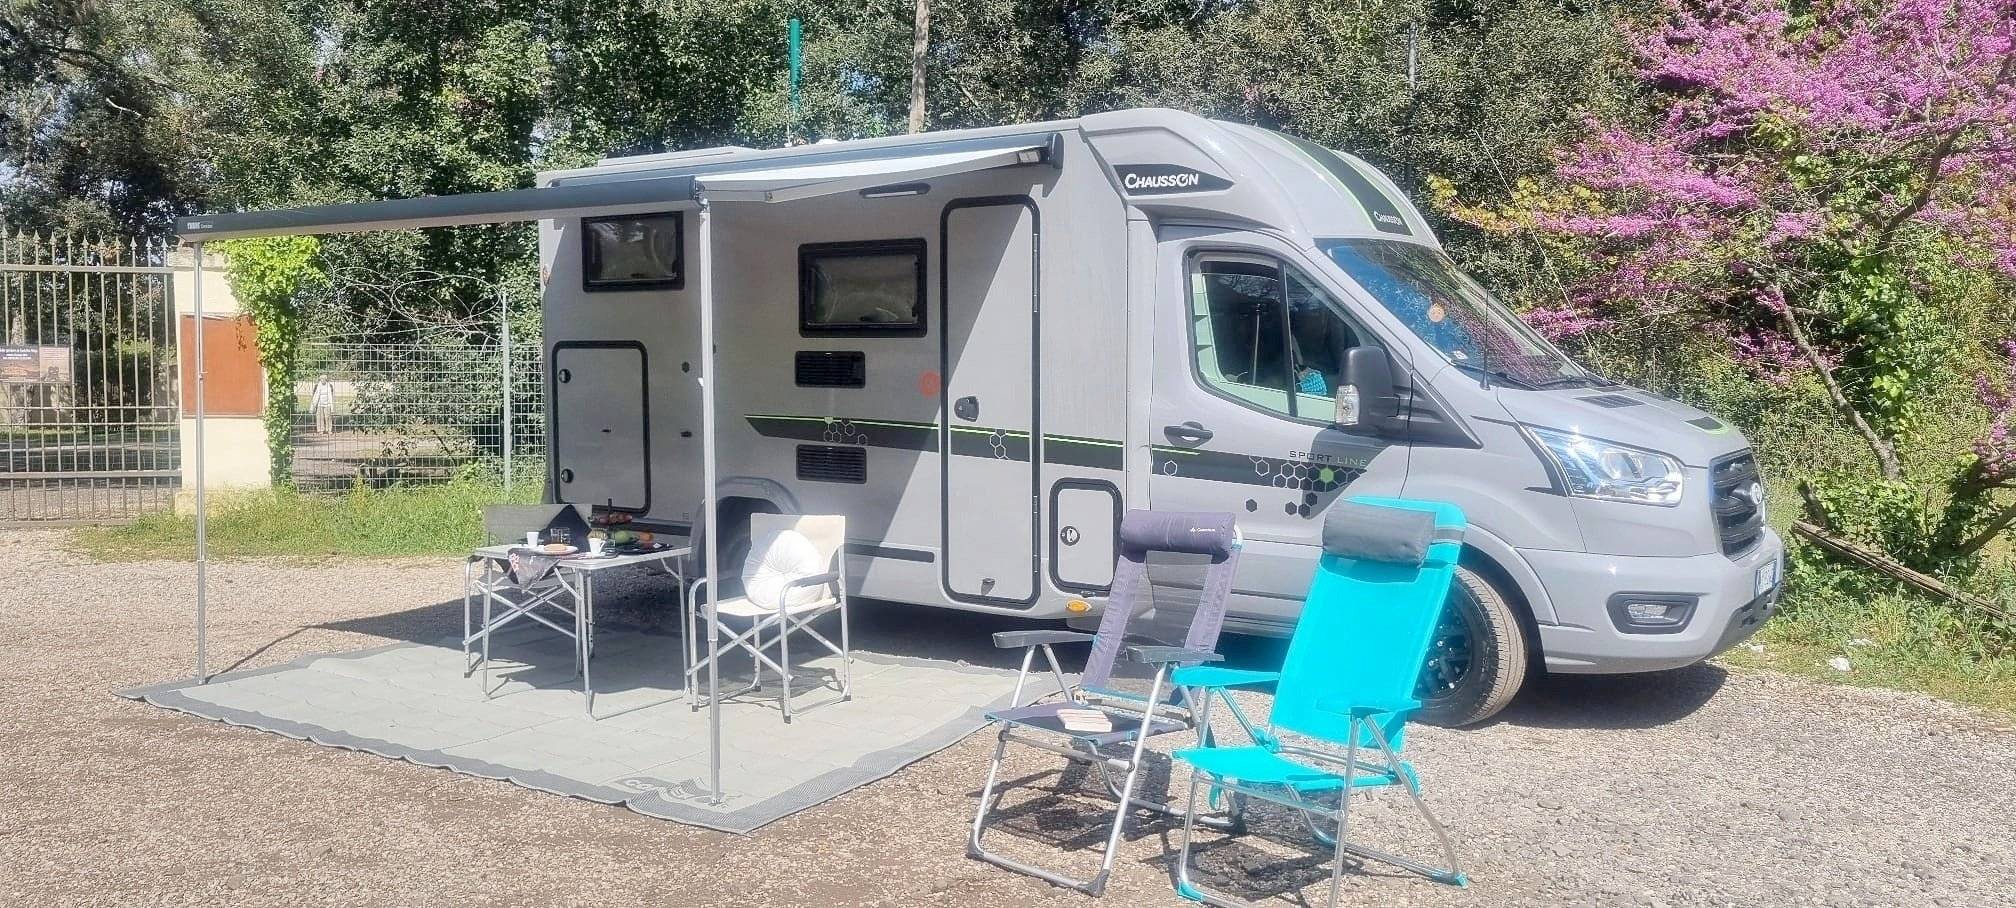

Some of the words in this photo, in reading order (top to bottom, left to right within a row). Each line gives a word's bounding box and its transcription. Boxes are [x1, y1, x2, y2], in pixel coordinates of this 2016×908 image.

[1124, 173, 1199, 189] CHAUSSON
[1289, 450, 1332, 462] SPORT
[1337, 455, 1367, 467] LINE
